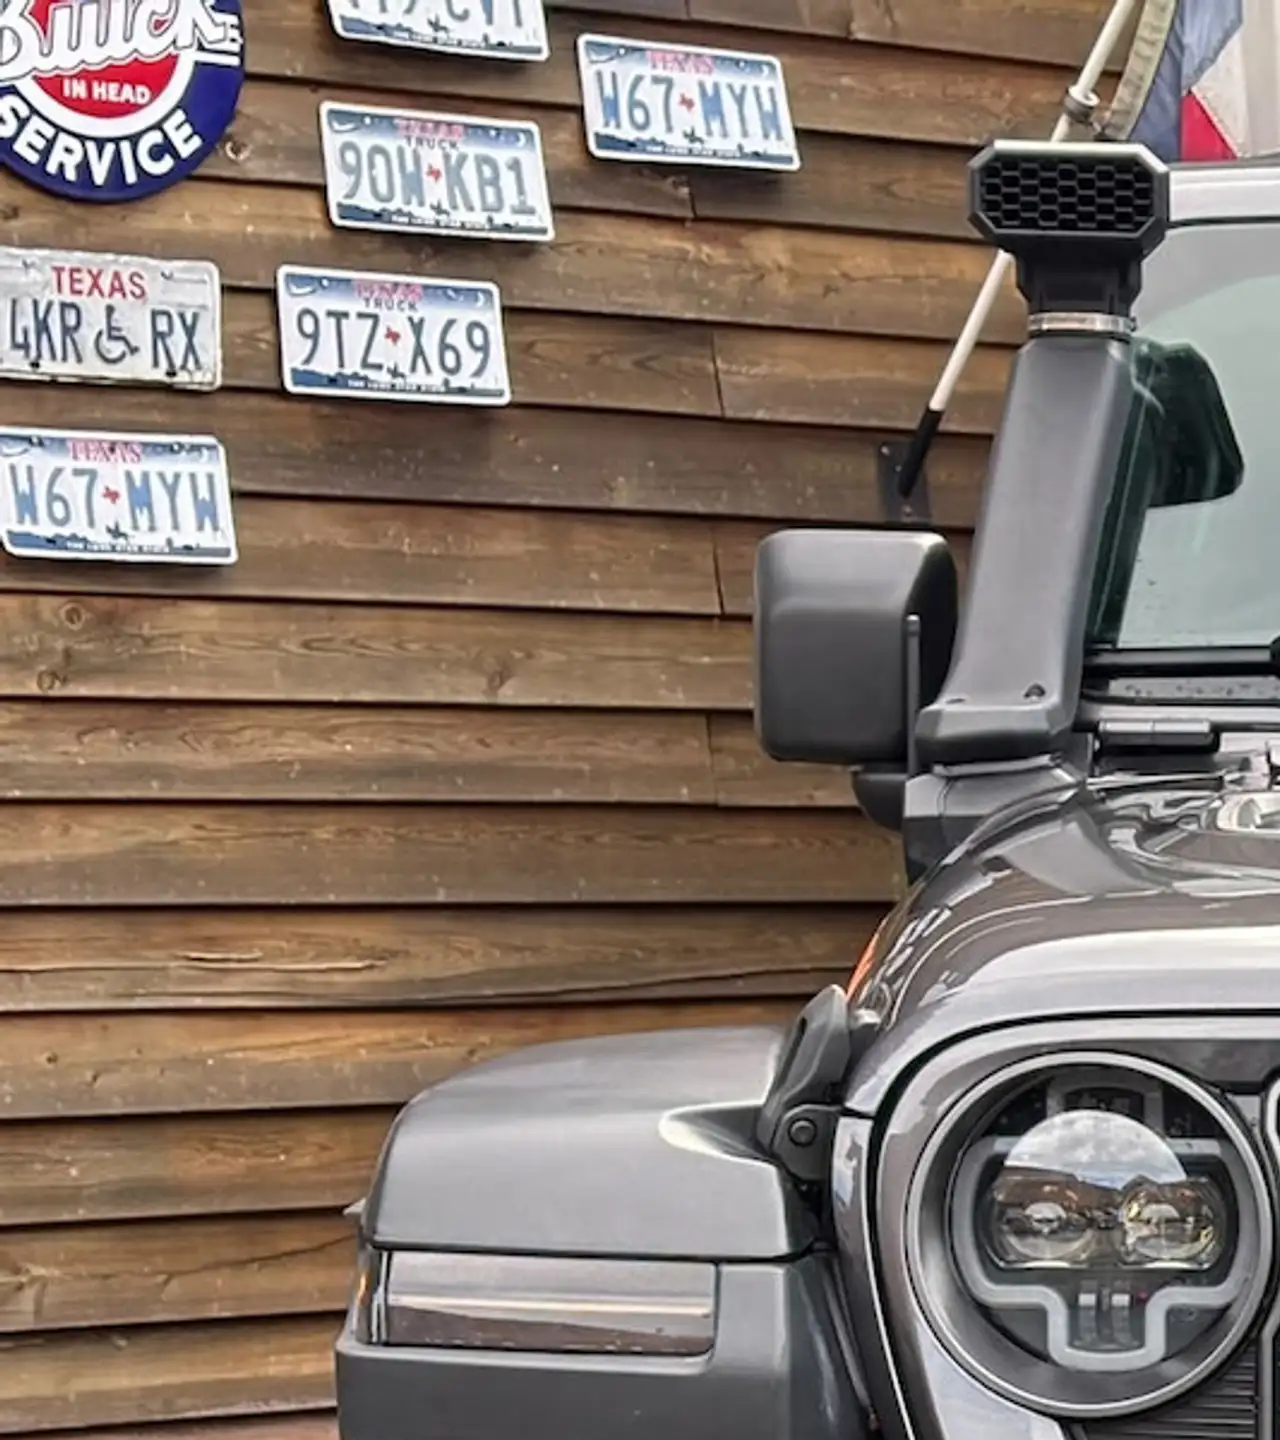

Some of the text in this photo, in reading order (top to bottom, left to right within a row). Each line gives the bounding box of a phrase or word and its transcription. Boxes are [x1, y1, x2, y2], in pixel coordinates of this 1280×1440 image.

[62, 77, 152, 105] IN HEAD
[596, 70, 784, 142] W67 MYW
[0, 94, 203, 187] SERVICE
[52, 266, 147, 299] TEXAS
[10, 298, 202, 371] 4KR RX
[296, 307, 491, 379] 9TZ X69
[9, 463, 219, 533] W67 MYW
